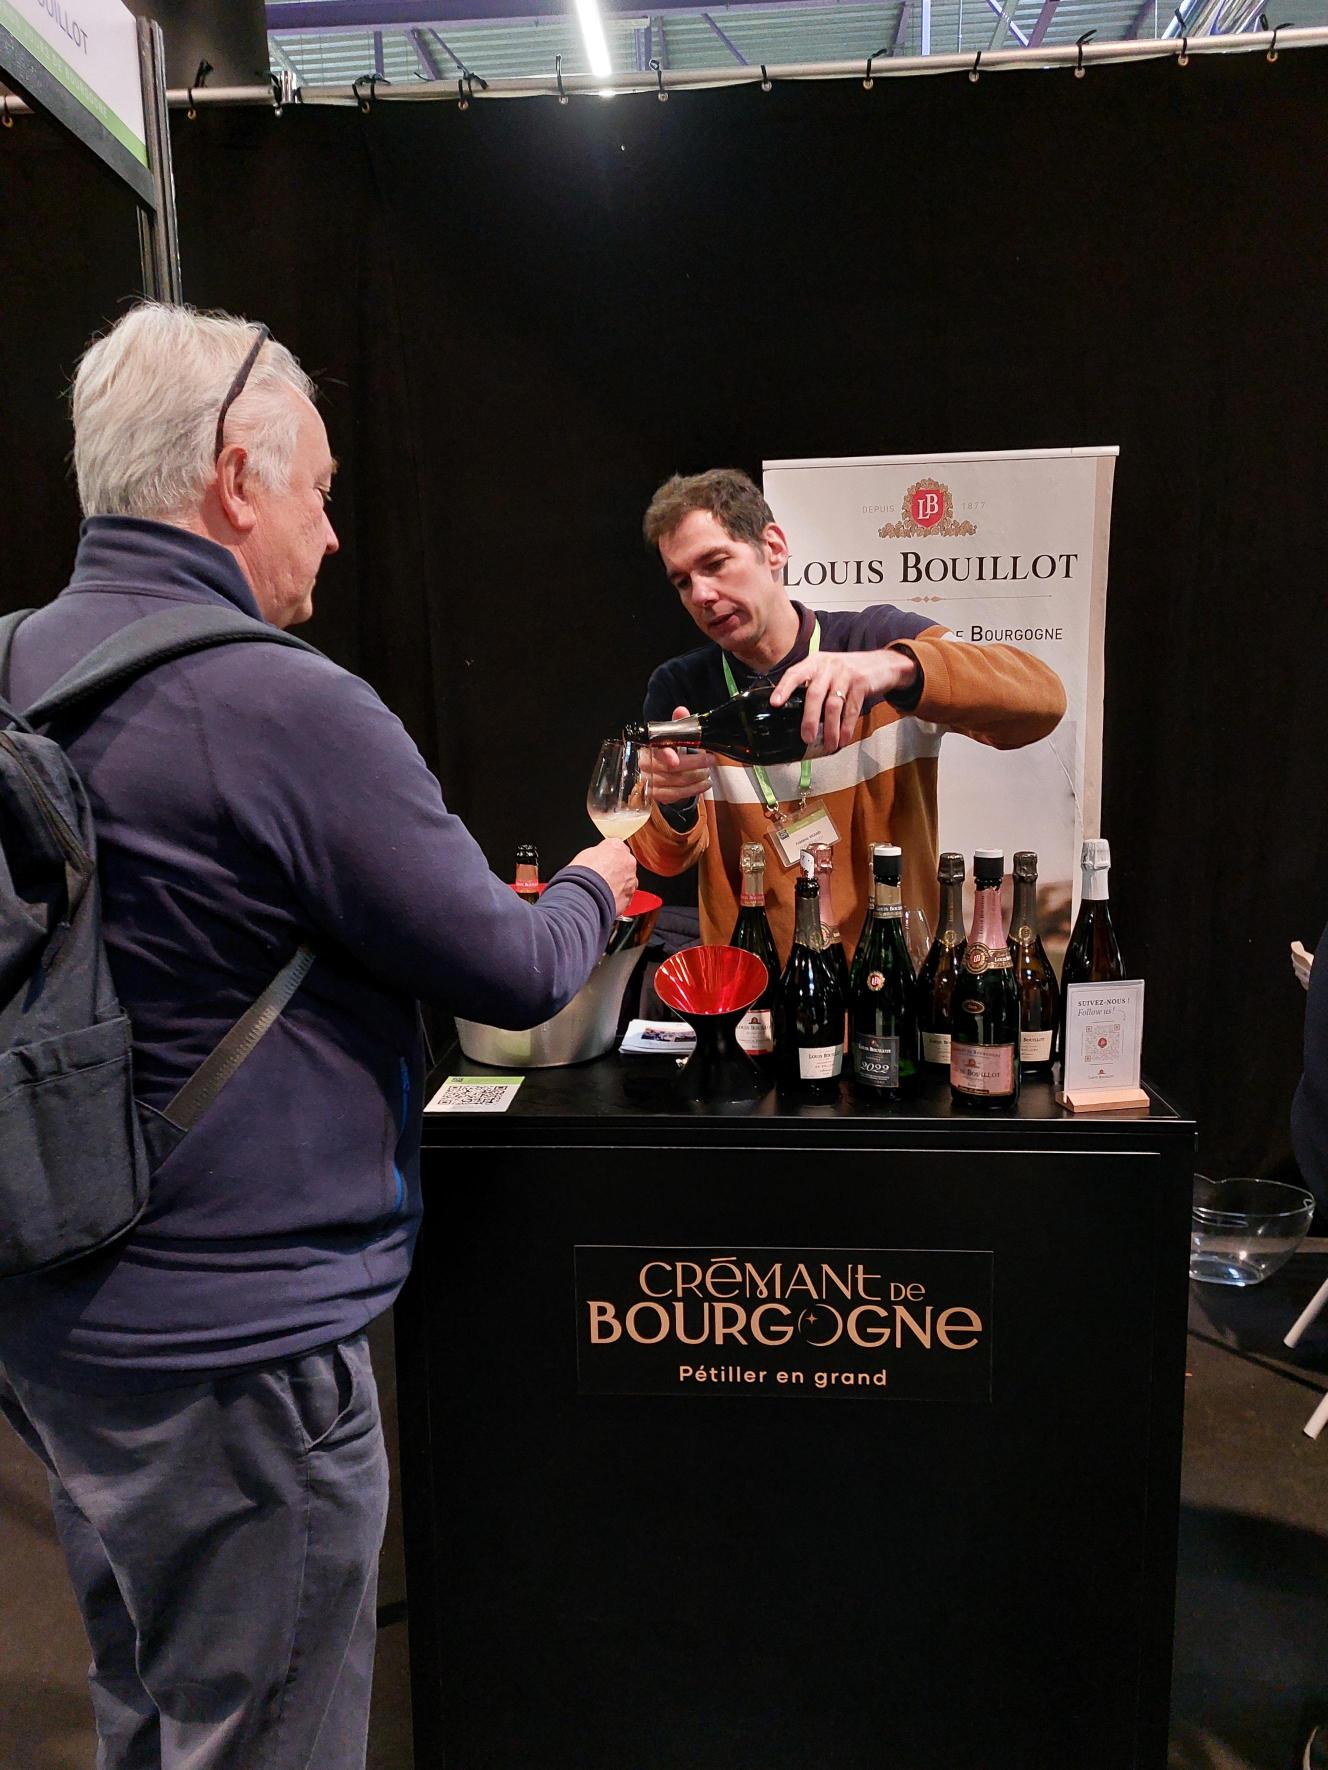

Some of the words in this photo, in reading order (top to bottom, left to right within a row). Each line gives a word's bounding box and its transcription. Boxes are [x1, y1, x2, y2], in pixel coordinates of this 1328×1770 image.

[37, 0, 88, 54] UILLOT
[862, 505, 895, 513] DEPUIS
[962, 501, 986, 510] 1877
[783, 555, 884, 586] LOUIS
[899, 551, 1078, 583] BOUILLOT
[971, 625, 1063, 641] BOURGOGNE
[1077, 1007, 1101, 1016] Follow
[860, 1061, 890, 1074] 2022
[679, 1365, 768, 1384] Pétiller
[776, 1370, 804, 1384] en
[814, 1369, 887, 1389] grand
